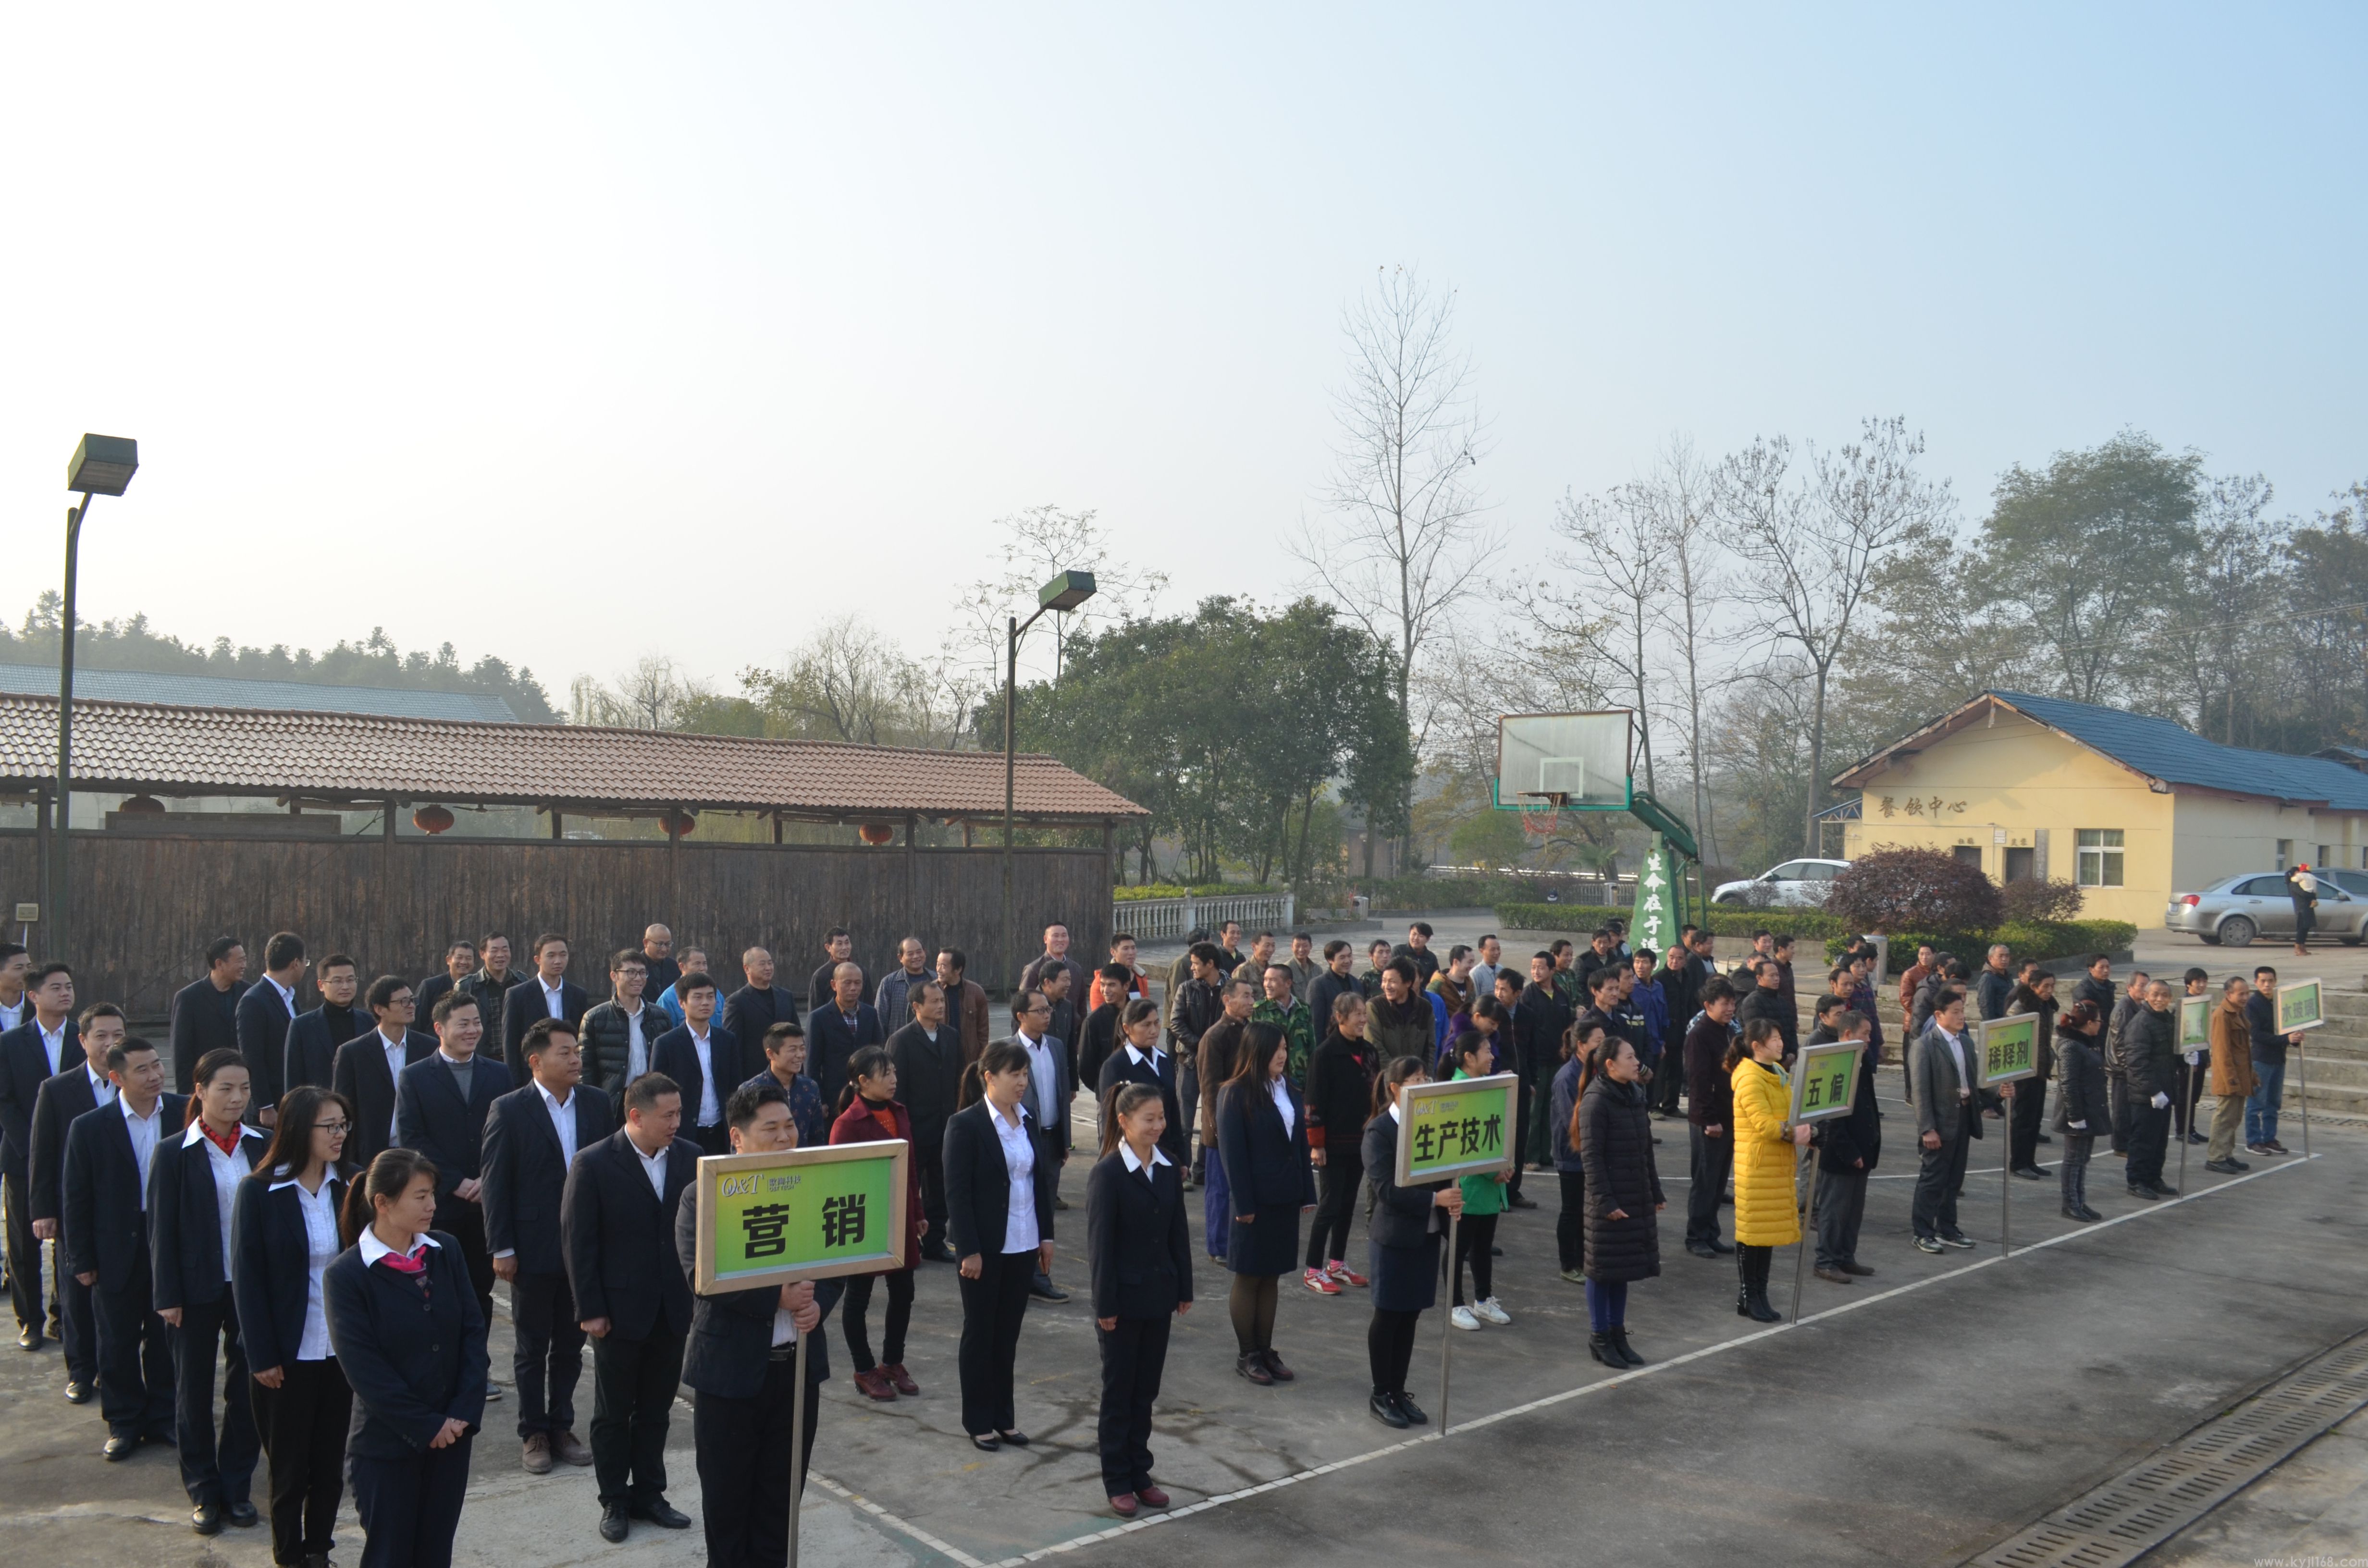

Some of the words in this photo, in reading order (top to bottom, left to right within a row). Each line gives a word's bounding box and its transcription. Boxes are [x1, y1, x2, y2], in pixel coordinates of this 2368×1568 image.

[1878, 796, 1967, 818] 餐饮中心
[1640, 853, 1669, 971] 生命在于运
[1988, 1039, 2029, 1072] 稀释剂
[1414, 1114, 1501, 1162] 生产技术
[742, 1193, 866, 1260] 营销
